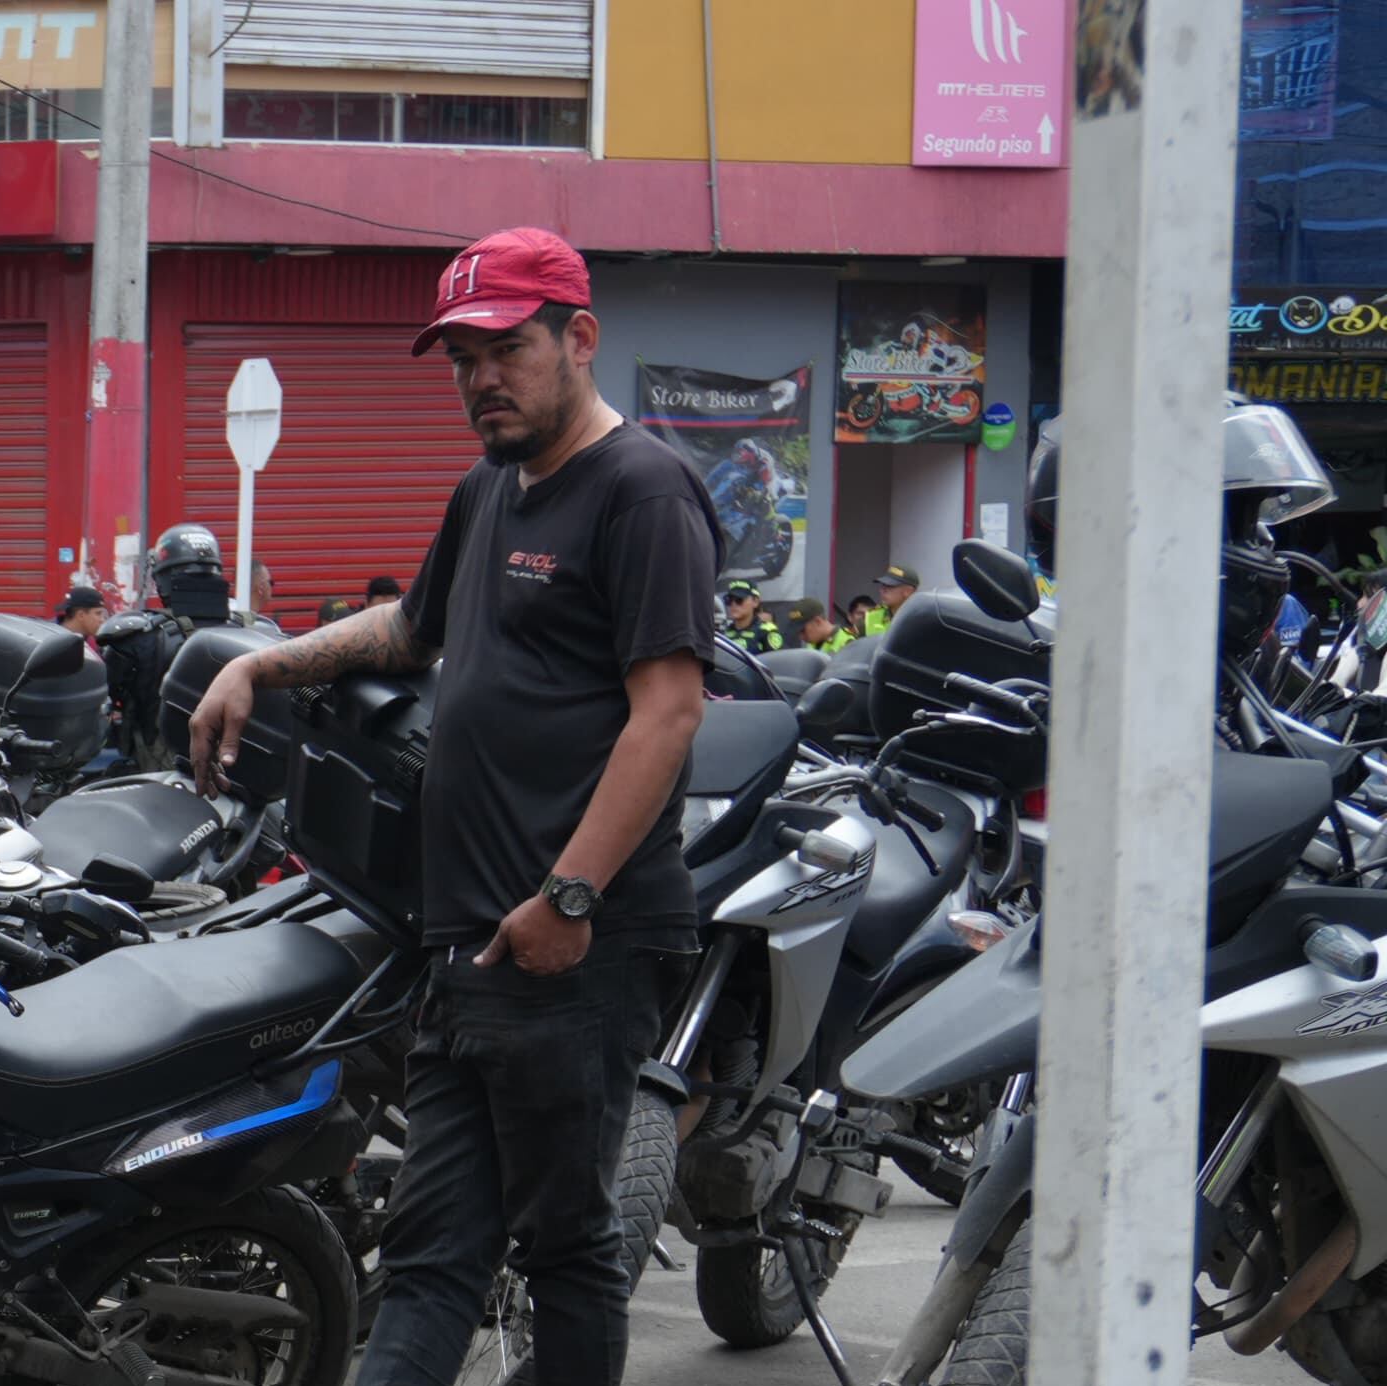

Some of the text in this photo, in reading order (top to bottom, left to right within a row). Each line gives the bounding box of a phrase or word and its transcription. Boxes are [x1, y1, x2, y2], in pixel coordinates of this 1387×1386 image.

[923, 133, 1032, 158] Segundo piso
[847, 350, 932, 371] Store Biker
[651, 385, 758, 409] Store Biker
[179, 819, 220, 854] HONDA
[249, 1017, 316, 1049] auteco
[124, 1131, 204, 1172] ENDURO
